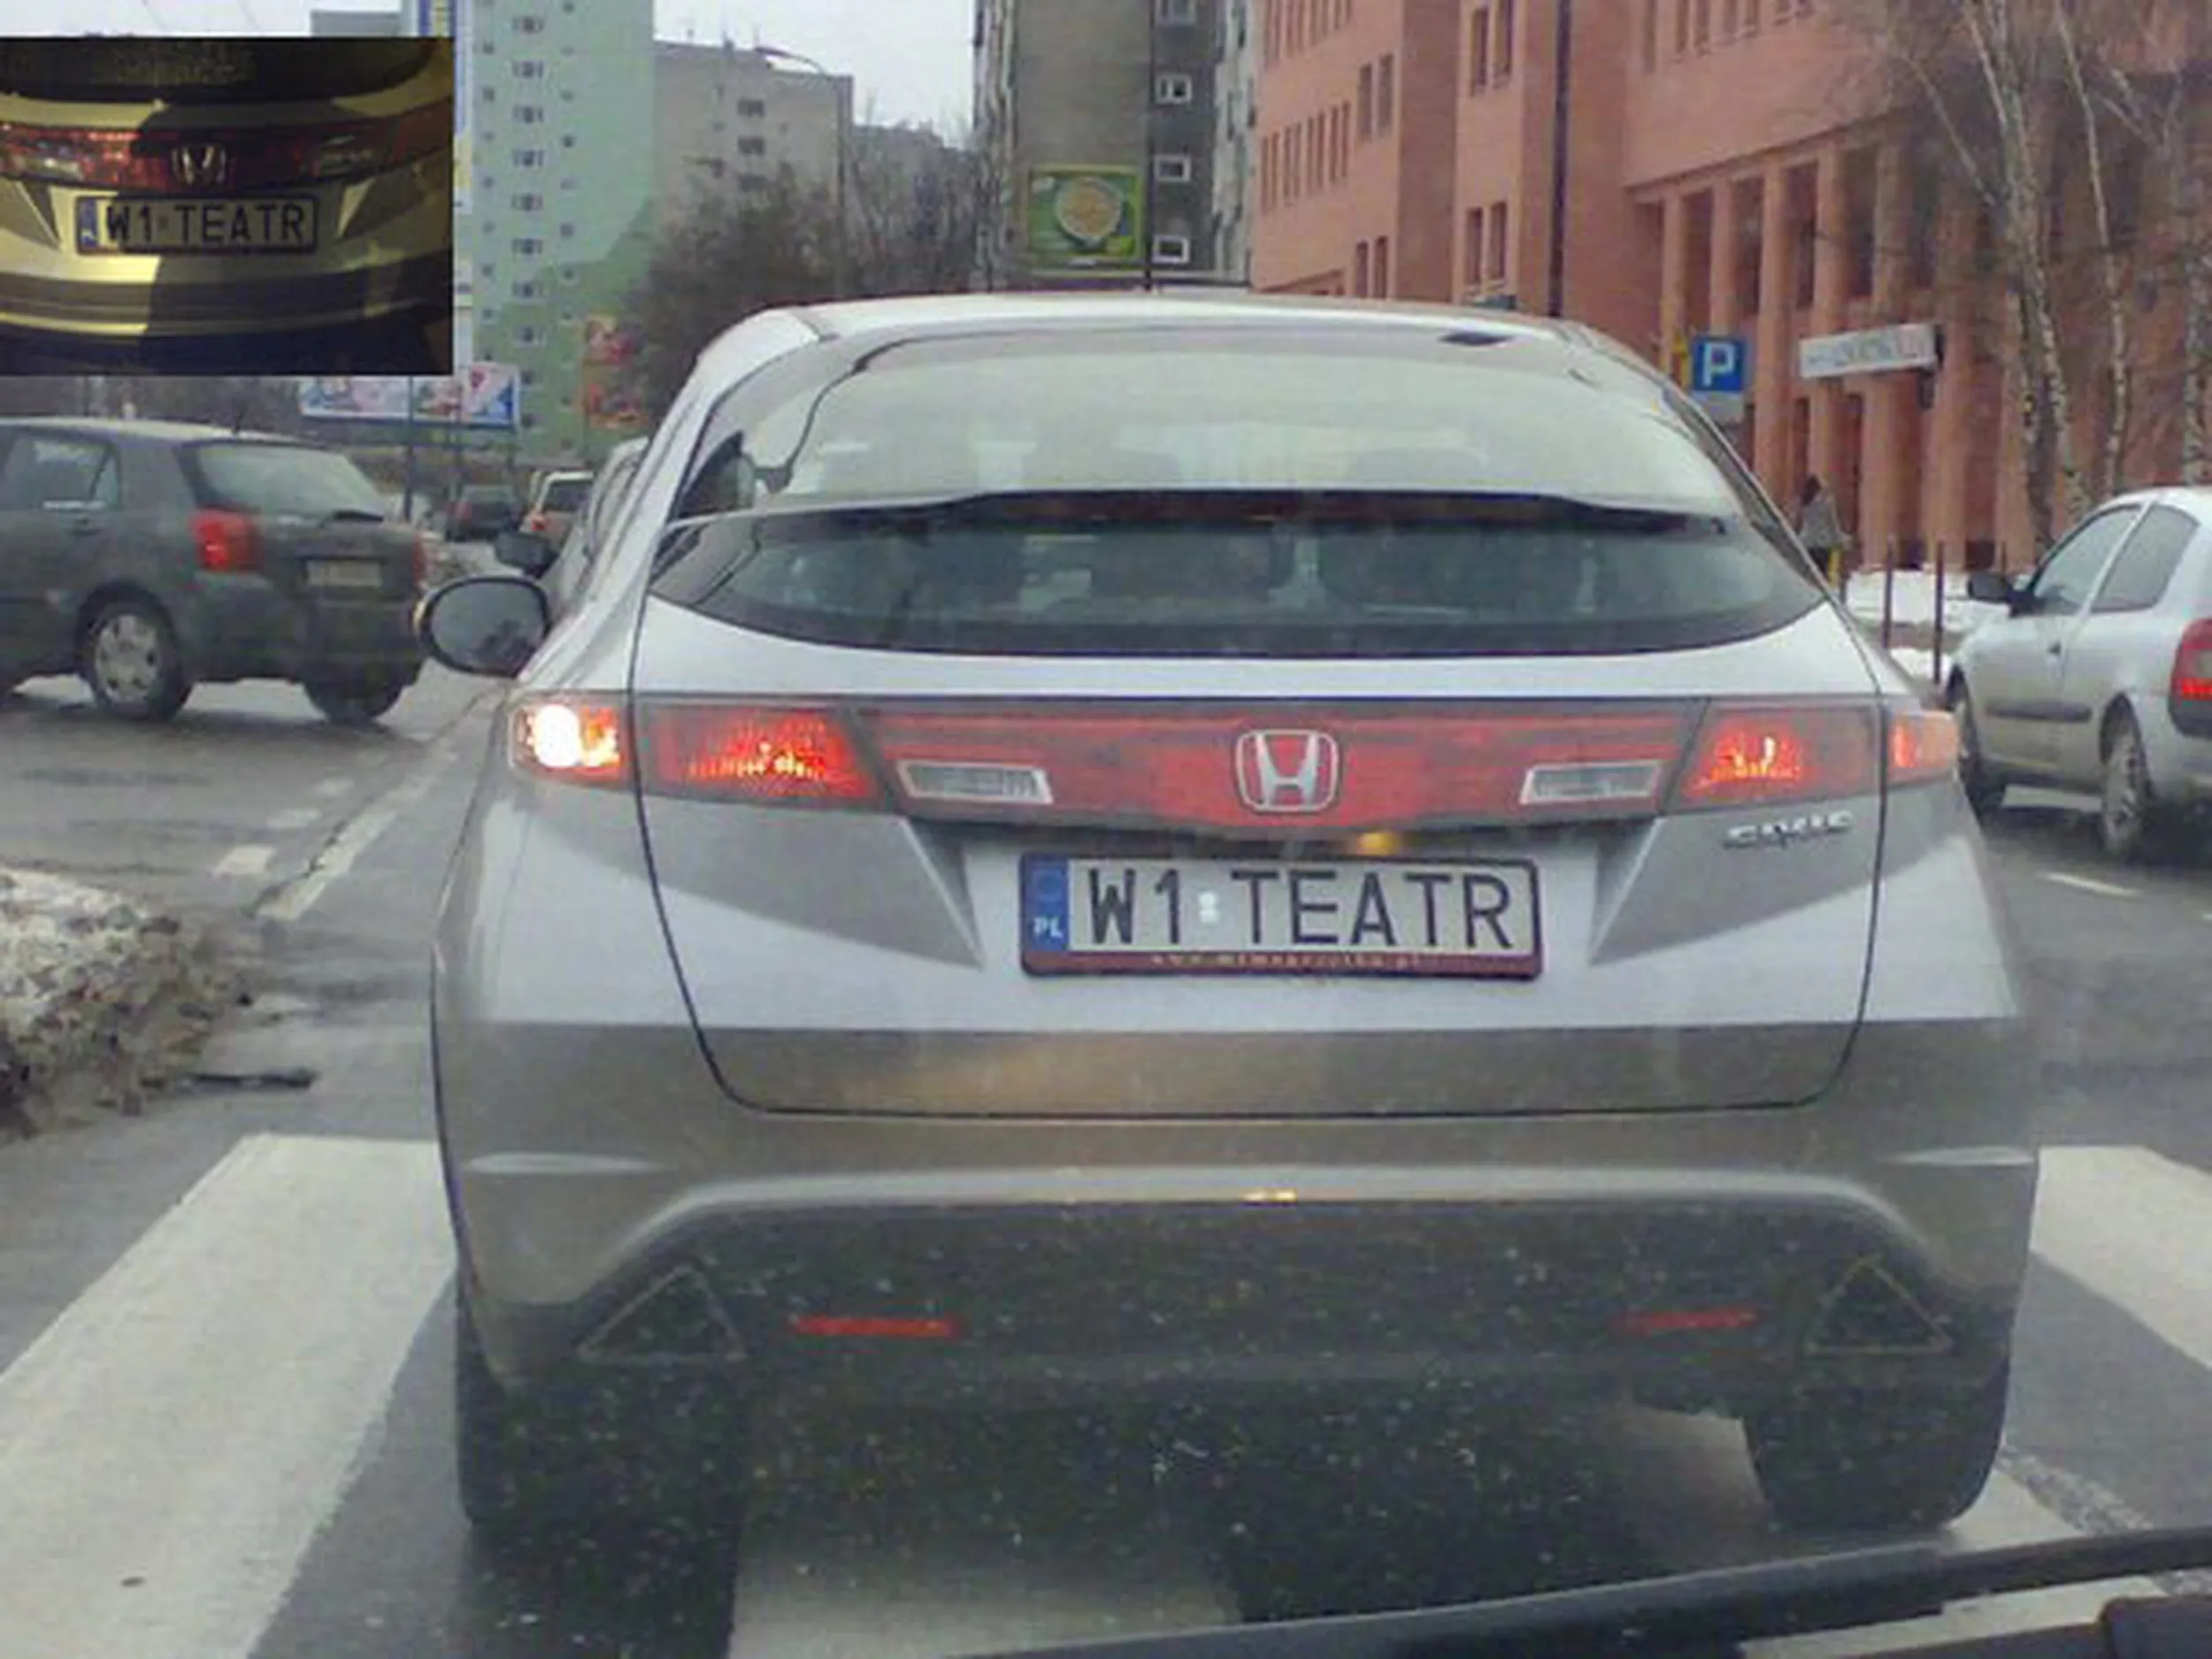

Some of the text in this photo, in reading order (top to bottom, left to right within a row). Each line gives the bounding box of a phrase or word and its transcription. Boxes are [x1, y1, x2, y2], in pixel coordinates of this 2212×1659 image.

[106, 204, 151, 242] W1
[174, 204, 304, 242] TEATR
[1703, 342, 1735, 387] P
[1033, 918, 1064, 938] PL
[1089, 867, 1512, 949] W1 TEATR
